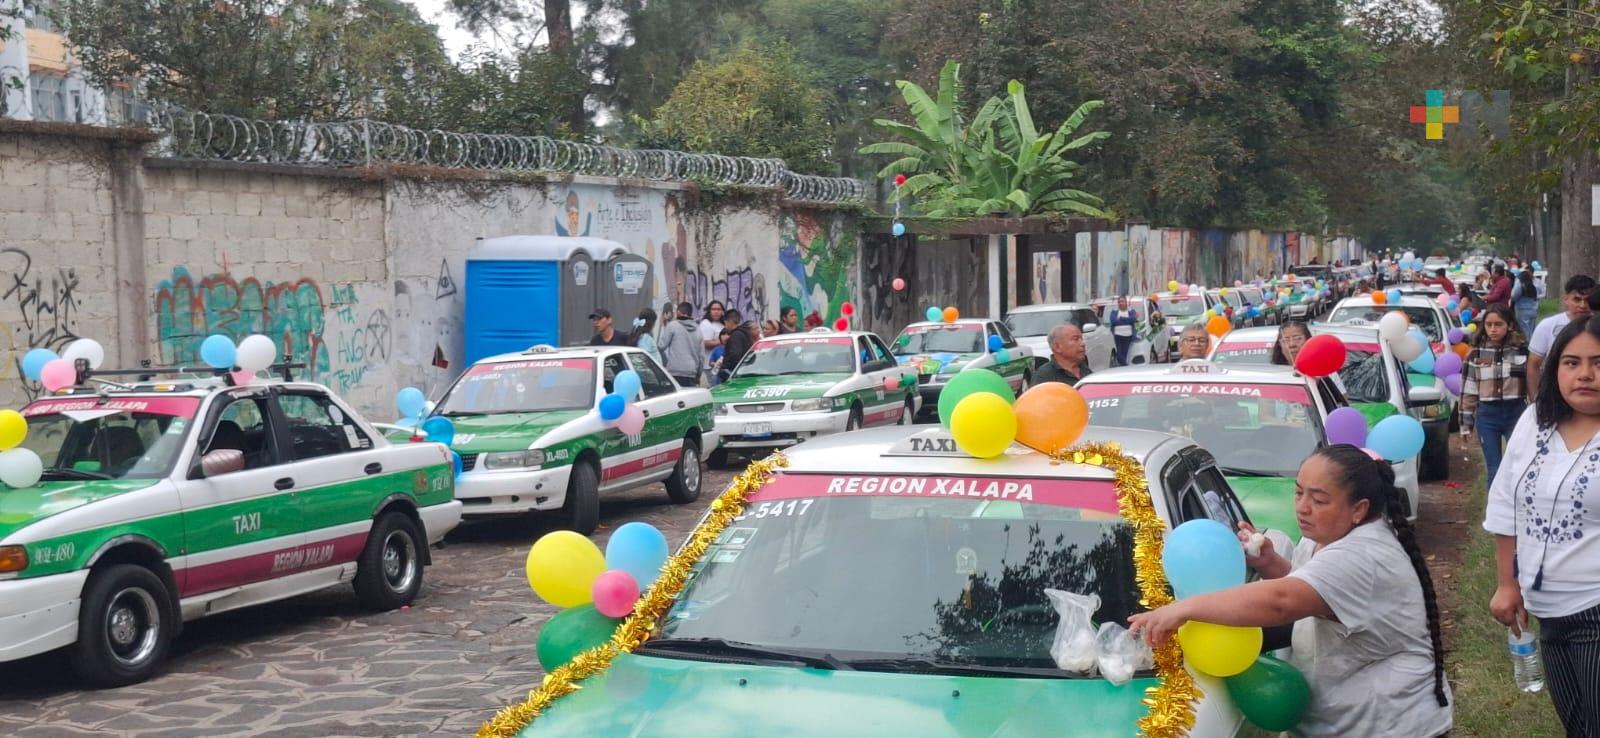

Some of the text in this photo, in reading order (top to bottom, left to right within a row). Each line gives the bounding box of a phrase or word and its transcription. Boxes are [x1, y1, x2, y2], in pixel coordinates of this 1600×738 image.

[1181, 364, 1209, 374] TAXI
[1131, 385, 1262, 396] REGION XALAPA
[54, 401, 97, 412] REGION
[827, 476, 1033, 500] REGION XALAPA
[232, 511, 261, 534] TAXI
[303, 544, 335, 567] XALAPA
